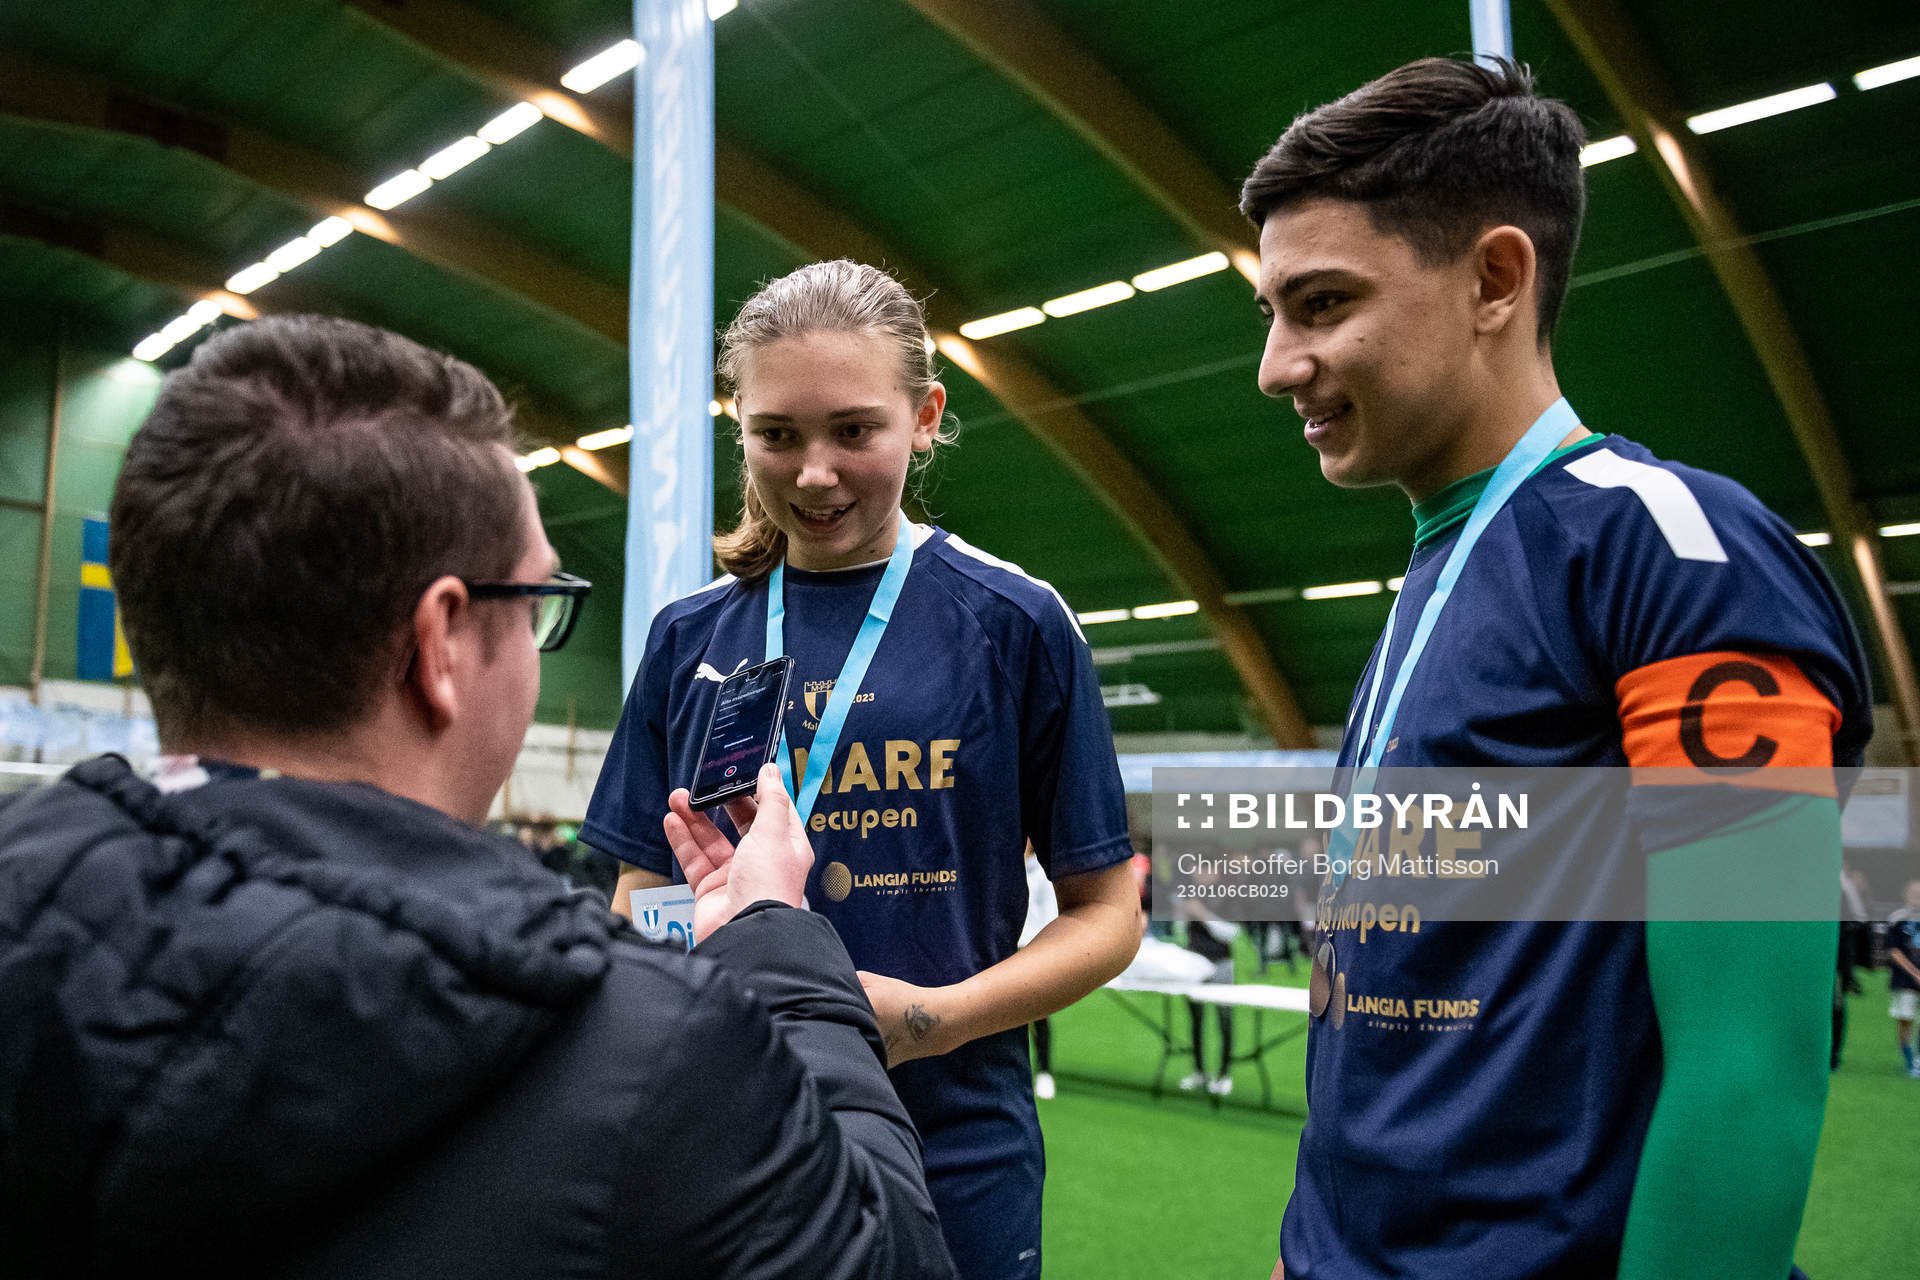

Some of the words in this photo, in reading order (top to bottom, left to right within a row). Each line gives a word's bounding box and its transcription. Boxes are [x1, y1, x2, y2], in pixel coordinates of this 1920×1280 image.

[854, 692, 875, 704] 023
[802, 720, 818, 731] Mal
[1680, 661, 1781, 776] C
[808, 807, 918, 839] ecupen
[854, 873, 909, 888] LANGIA
[911, 870, 957, 885] FUNDS
[1347, 994, 1409, 1019] LANGIA
[1414, 999, 1480, 1019] FUNDS
